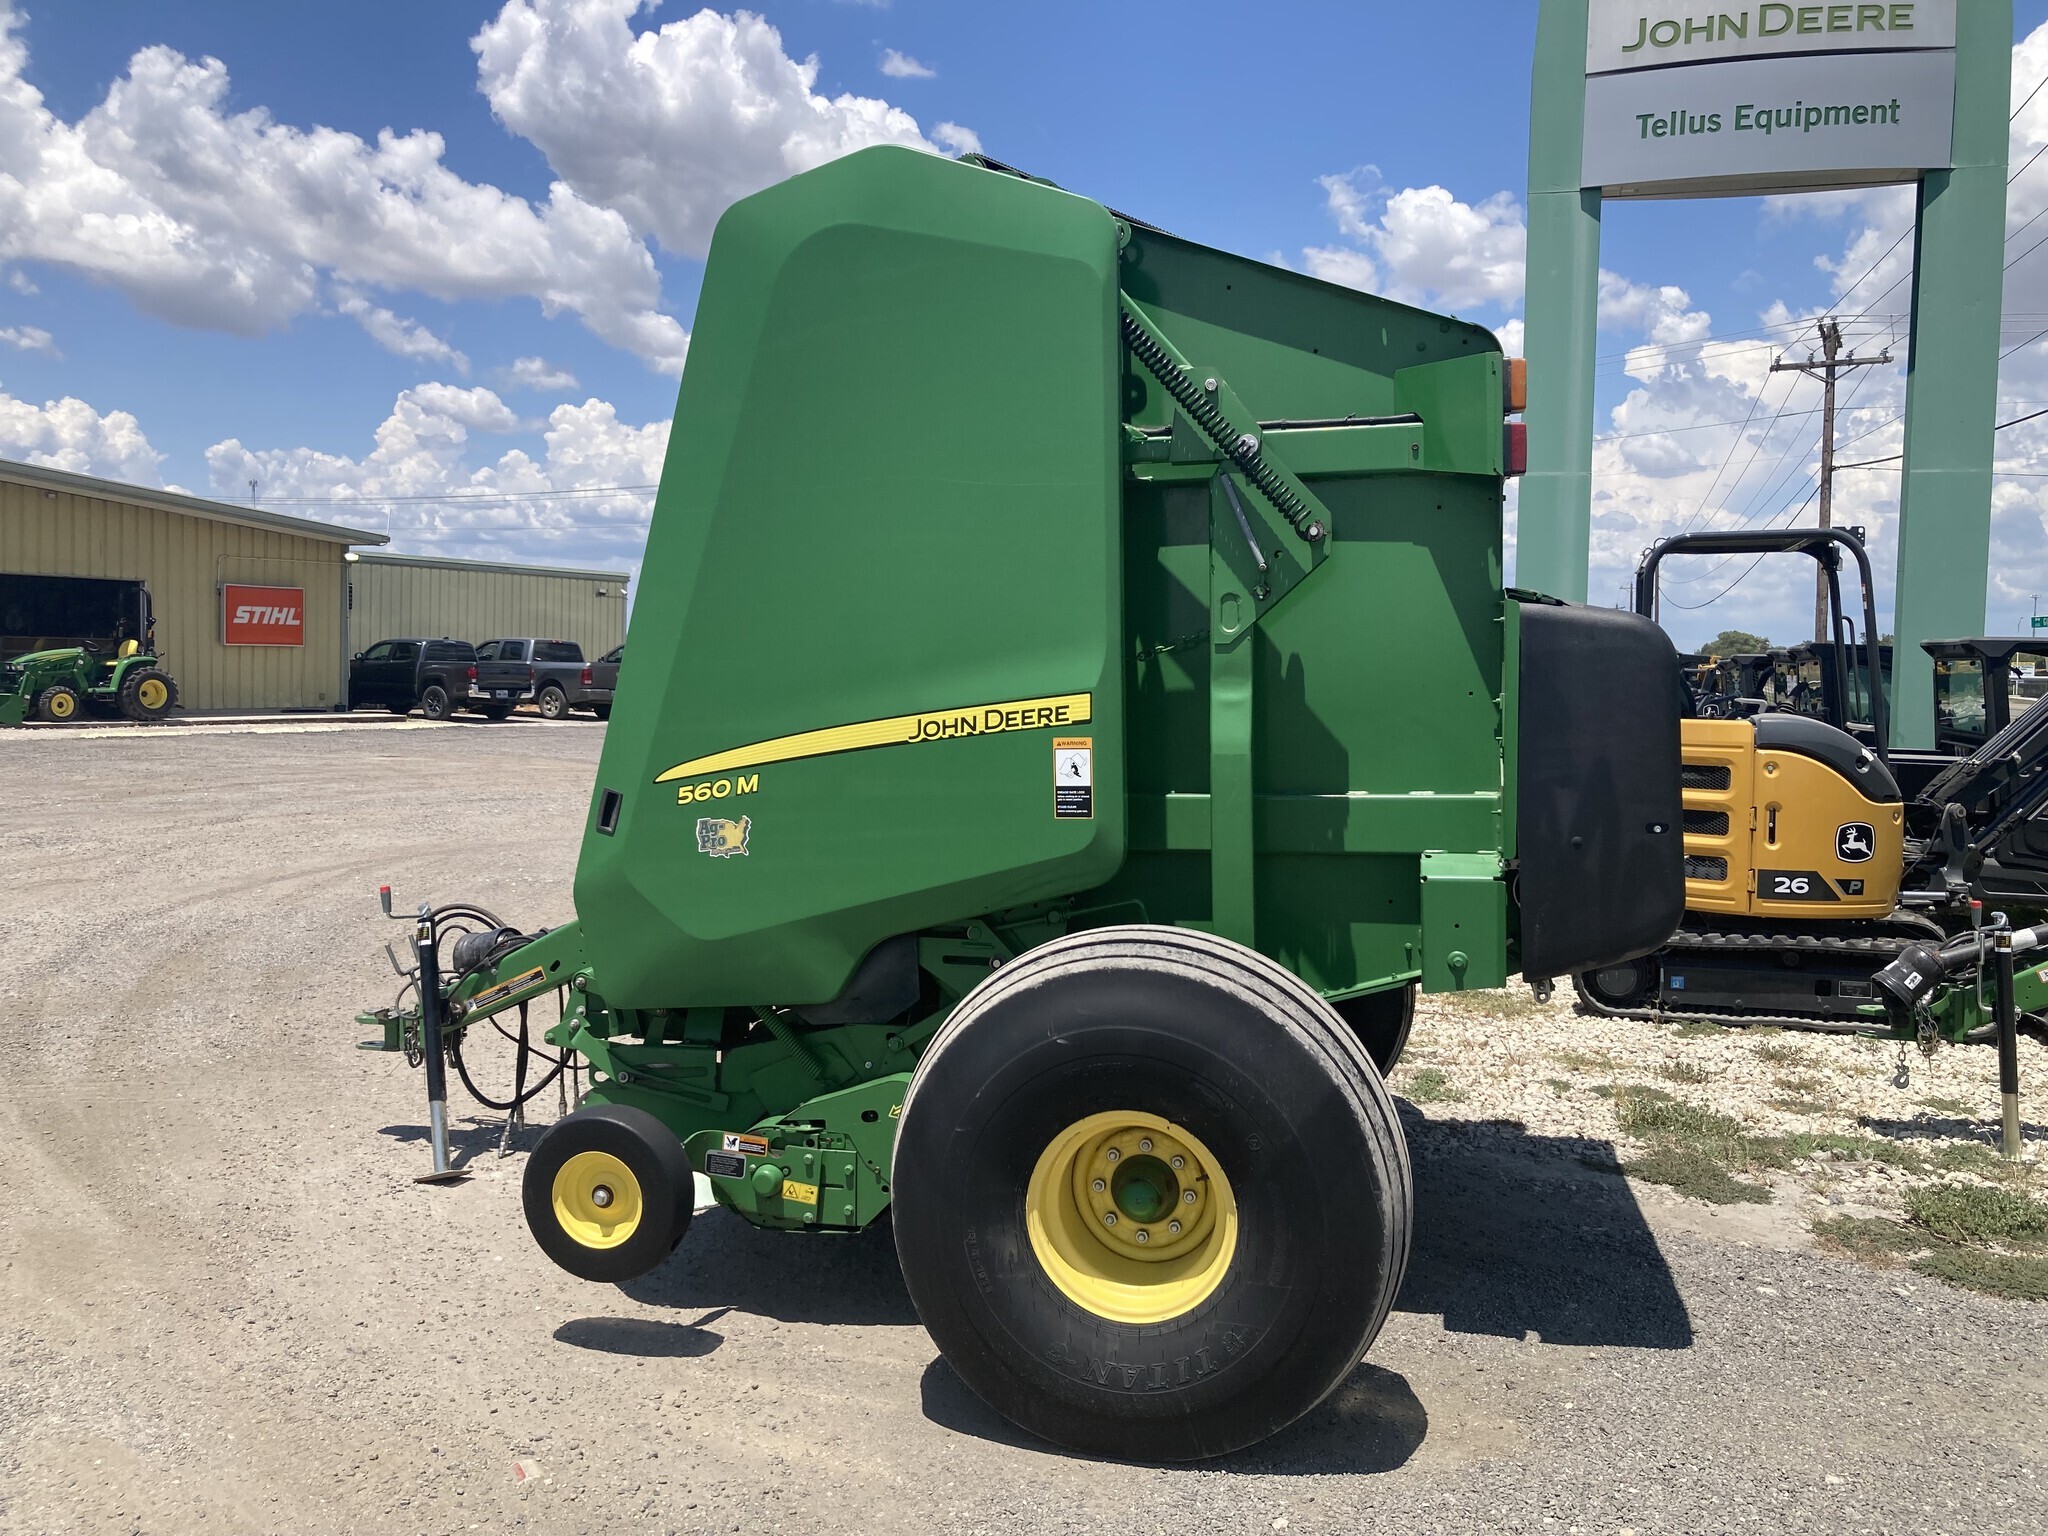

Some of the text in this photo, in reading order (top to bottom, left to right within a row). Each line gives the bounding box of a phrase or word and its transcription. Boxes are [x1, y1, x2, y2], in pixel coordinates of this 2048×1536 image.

[1621, 3, 1915, 53] JOHN DEERE
[1635, 98, 1901, 140] Tellus Equipment
[233, 605, 301, 626] STIHL
[907, 704, 1071, 741] JOHN DEERE
[677, 773, 760, 806] 560 M
[1774, 876, 1862, 894] 26 P
[1080, 1346, 1218, 1391] TITAN
